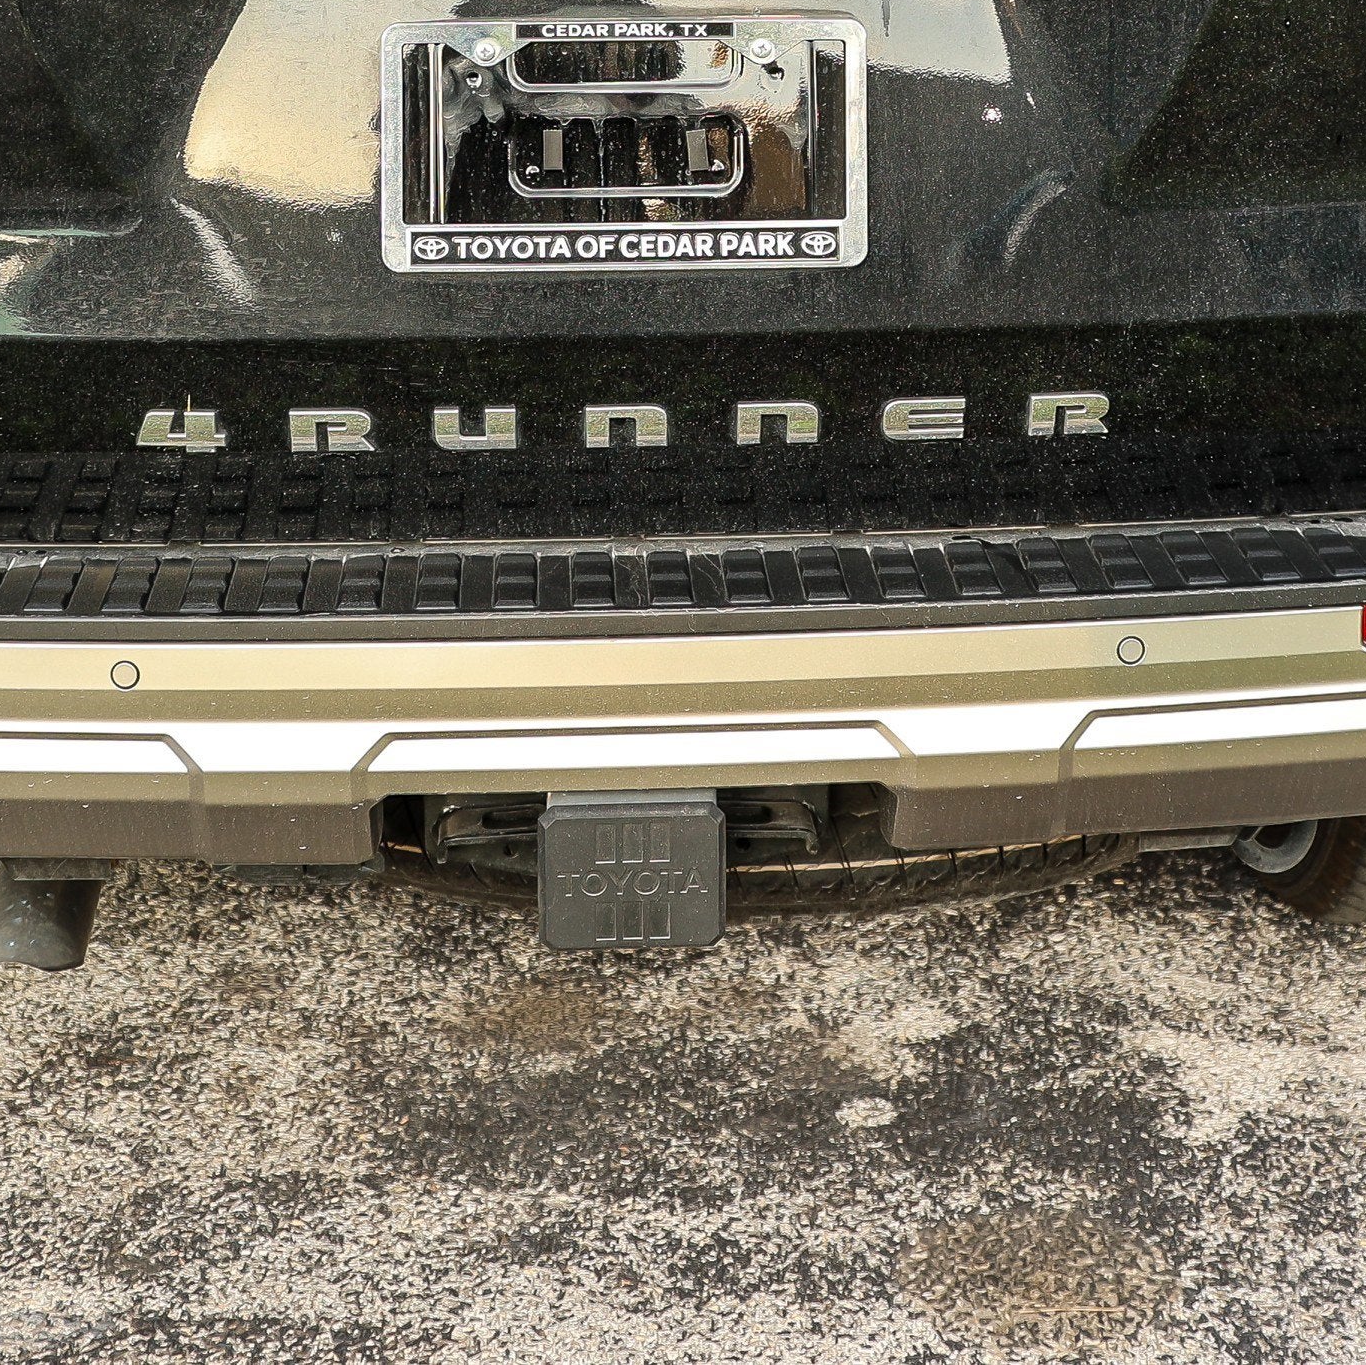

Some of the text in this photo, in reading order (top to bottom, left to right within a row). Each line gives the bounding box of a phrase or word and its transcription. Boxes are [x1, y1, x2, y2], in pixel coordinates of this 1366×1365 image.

[541, 23, 708, 37] CEDAR PARK, TX
[452, 232, 795, 260] TOYOTA OF CEDAR PARK
[136, 391, 1111, 454] 4RUNNER
[556, 866, 709, 897] TOYOTA
